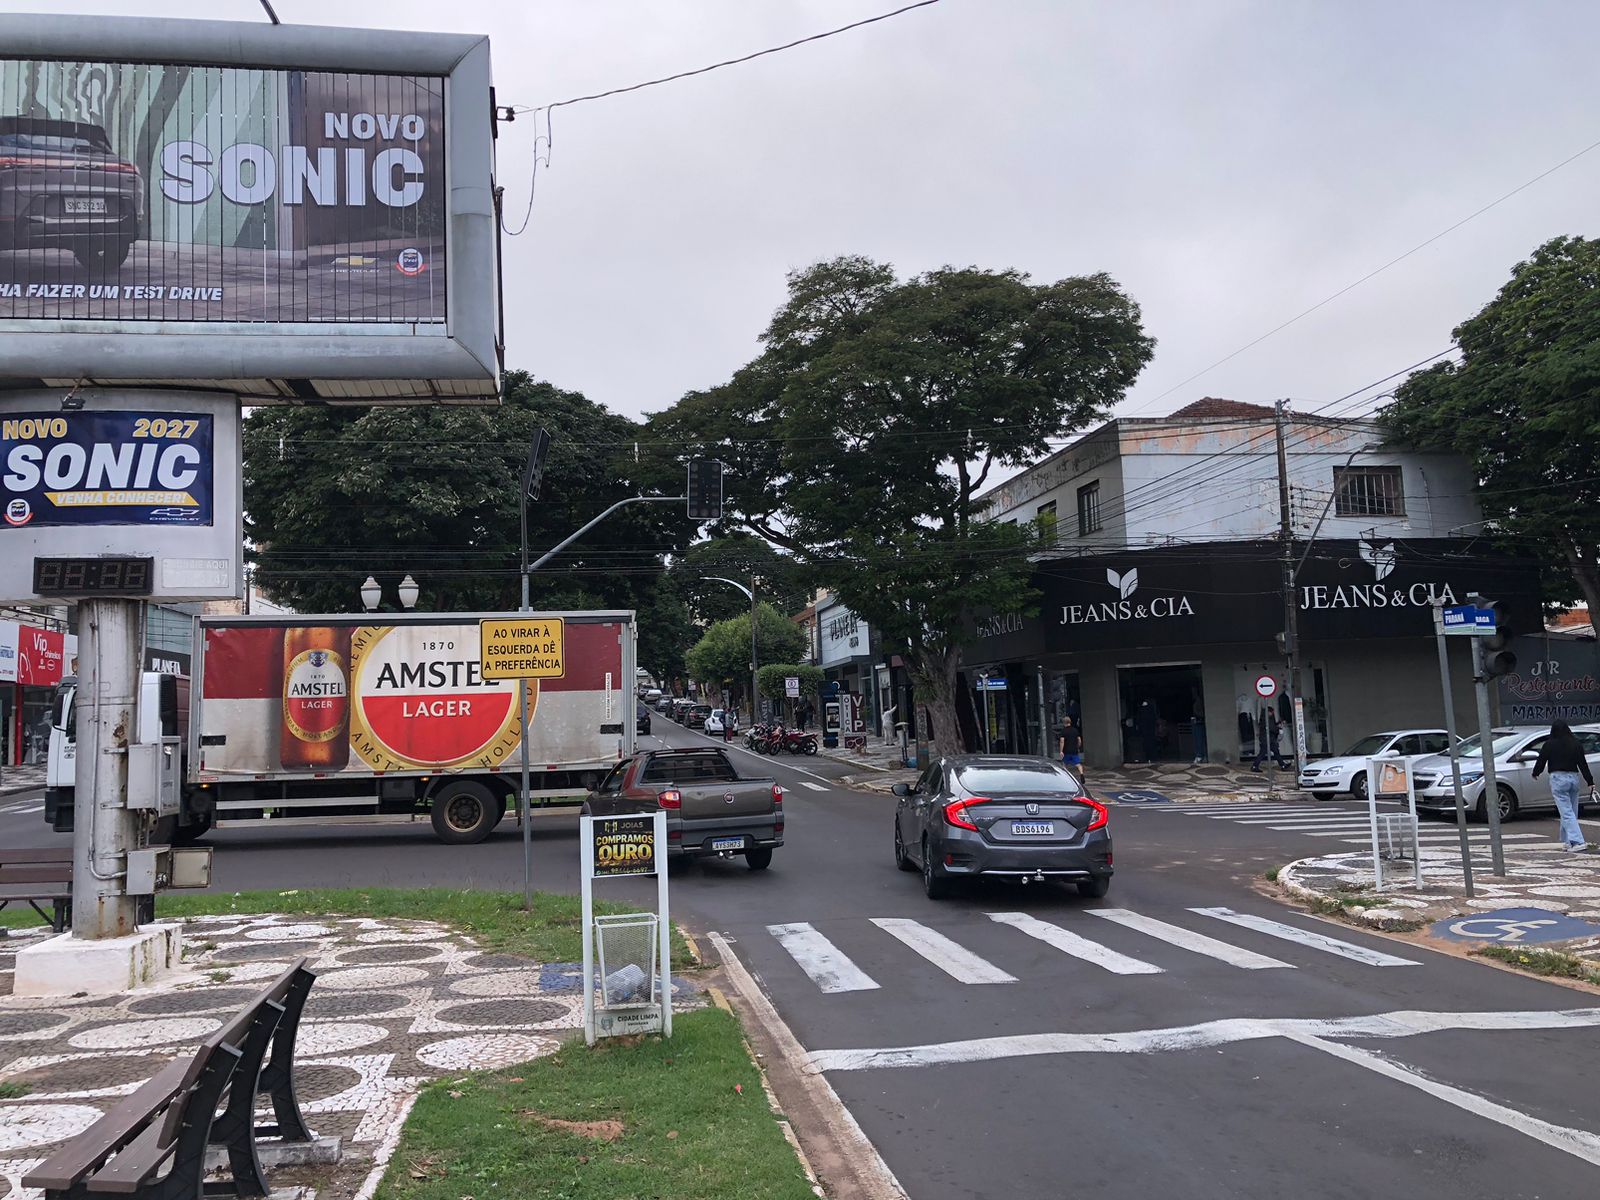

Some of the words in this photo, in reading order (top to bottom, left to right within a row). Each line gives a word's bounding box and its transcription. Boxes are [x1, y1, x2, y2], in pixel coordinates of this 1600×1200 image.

[325, 111, 425, 141] NOVO
[159, 140, 425, 207] SONIC
[26, 283, 86, 298] FAZER
[89, 284, 119, 299] UM
[123, 286, 166, 299] TEST
[169, 286, 223, 300] DRIVE
[2, 418, 68, 440] NOVO
[132, 418, 199, 439] 2027
[3, 442, 200, 492] SONIC
[57, 493, 102, 505] VENHA
[106, 492, 186, 504] CONHECER!
[493, 629, 507, 638] AO
[511, 628, 540, 638] VIRAR
[543, 624, 550, 637] À
[33, 632, 48, 656] Vip
[422, 641, 454, 650] 1870
[488, 644, 540, 655] ESQUERDA
[543, 640, 556, 653] DÊ
[484, 661, 491, 671] A
[495, 656, 561, 670] PREFERÊNCIA
[375, 661, 500, 689] AMSTE
[291, 682, 343, 696] AMSTEL
[301, 700, 333, 709] LAGER
[403, 700, 471, 718] LAGER
[1512, 704, 1600, 720] MARMITARIA
[596, 834, 654, 846] COMPRAMOS
[598, 843, 652, 861] OURO
